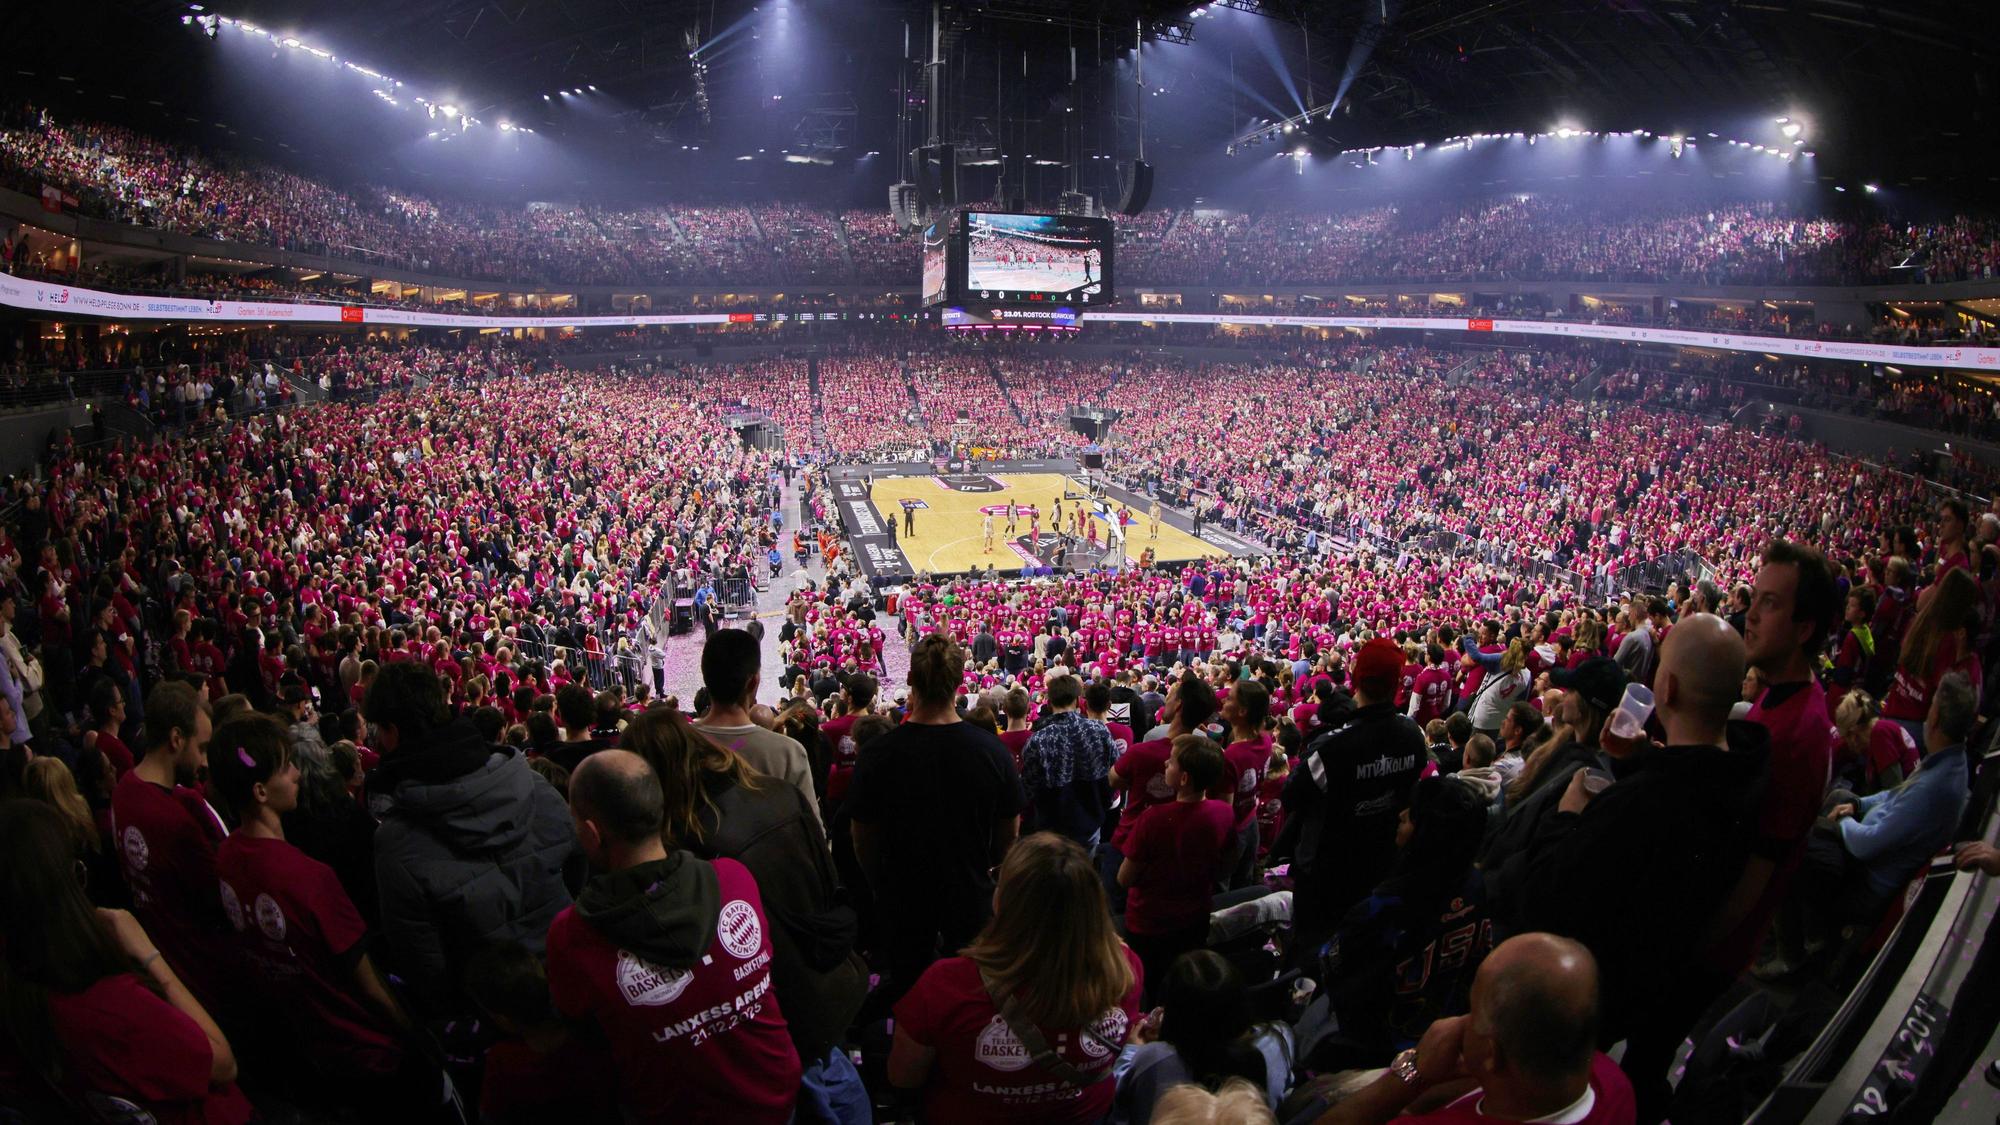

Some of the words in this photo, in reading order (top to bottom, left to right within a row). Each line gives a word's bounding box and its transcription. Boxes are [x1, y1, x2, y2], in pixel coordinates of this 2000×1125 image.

[998, 291, 1004, 299] 0
[1066, 293, 1072, 301] 4
[725, 904, 754, 918] BAYERN
[652, 1002, 733, 1042] LANXESS
[981, 1045, 1030, 1057] BASKET
[973, 1081, 1055, 1096] LANXESS
